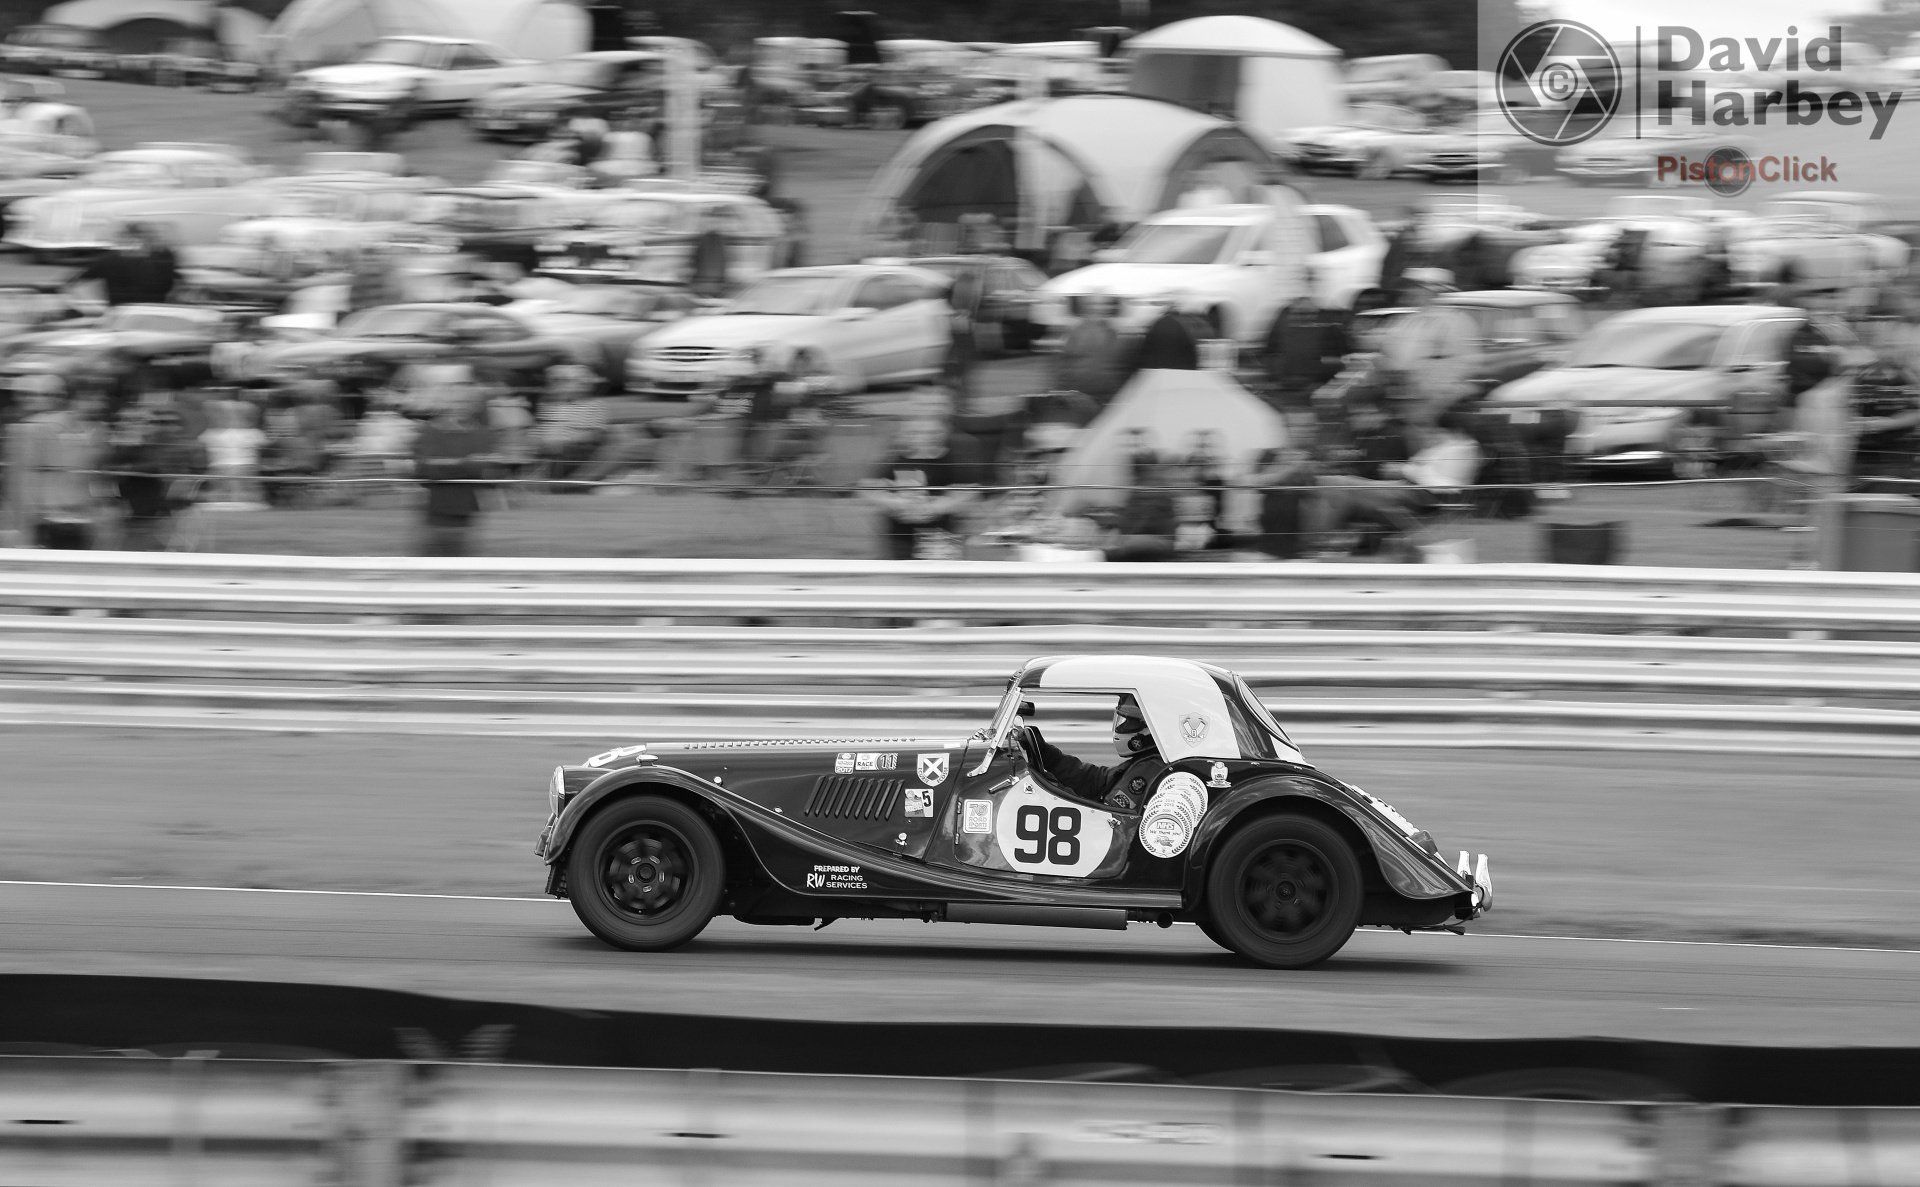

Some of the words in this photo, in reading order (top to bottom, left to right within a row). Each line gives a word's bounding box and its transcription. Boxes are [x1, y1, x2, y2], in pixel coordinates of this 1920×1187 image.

[921, 790, 932, 807] 5
[1014, 804, 1082, 866] 98
[814, 865, 850, 873] PREPARED
[806, 872, 826, 889] RW
[830, 874, 864, 882] RACING
[825, 881, 868, 889] SERVICES
